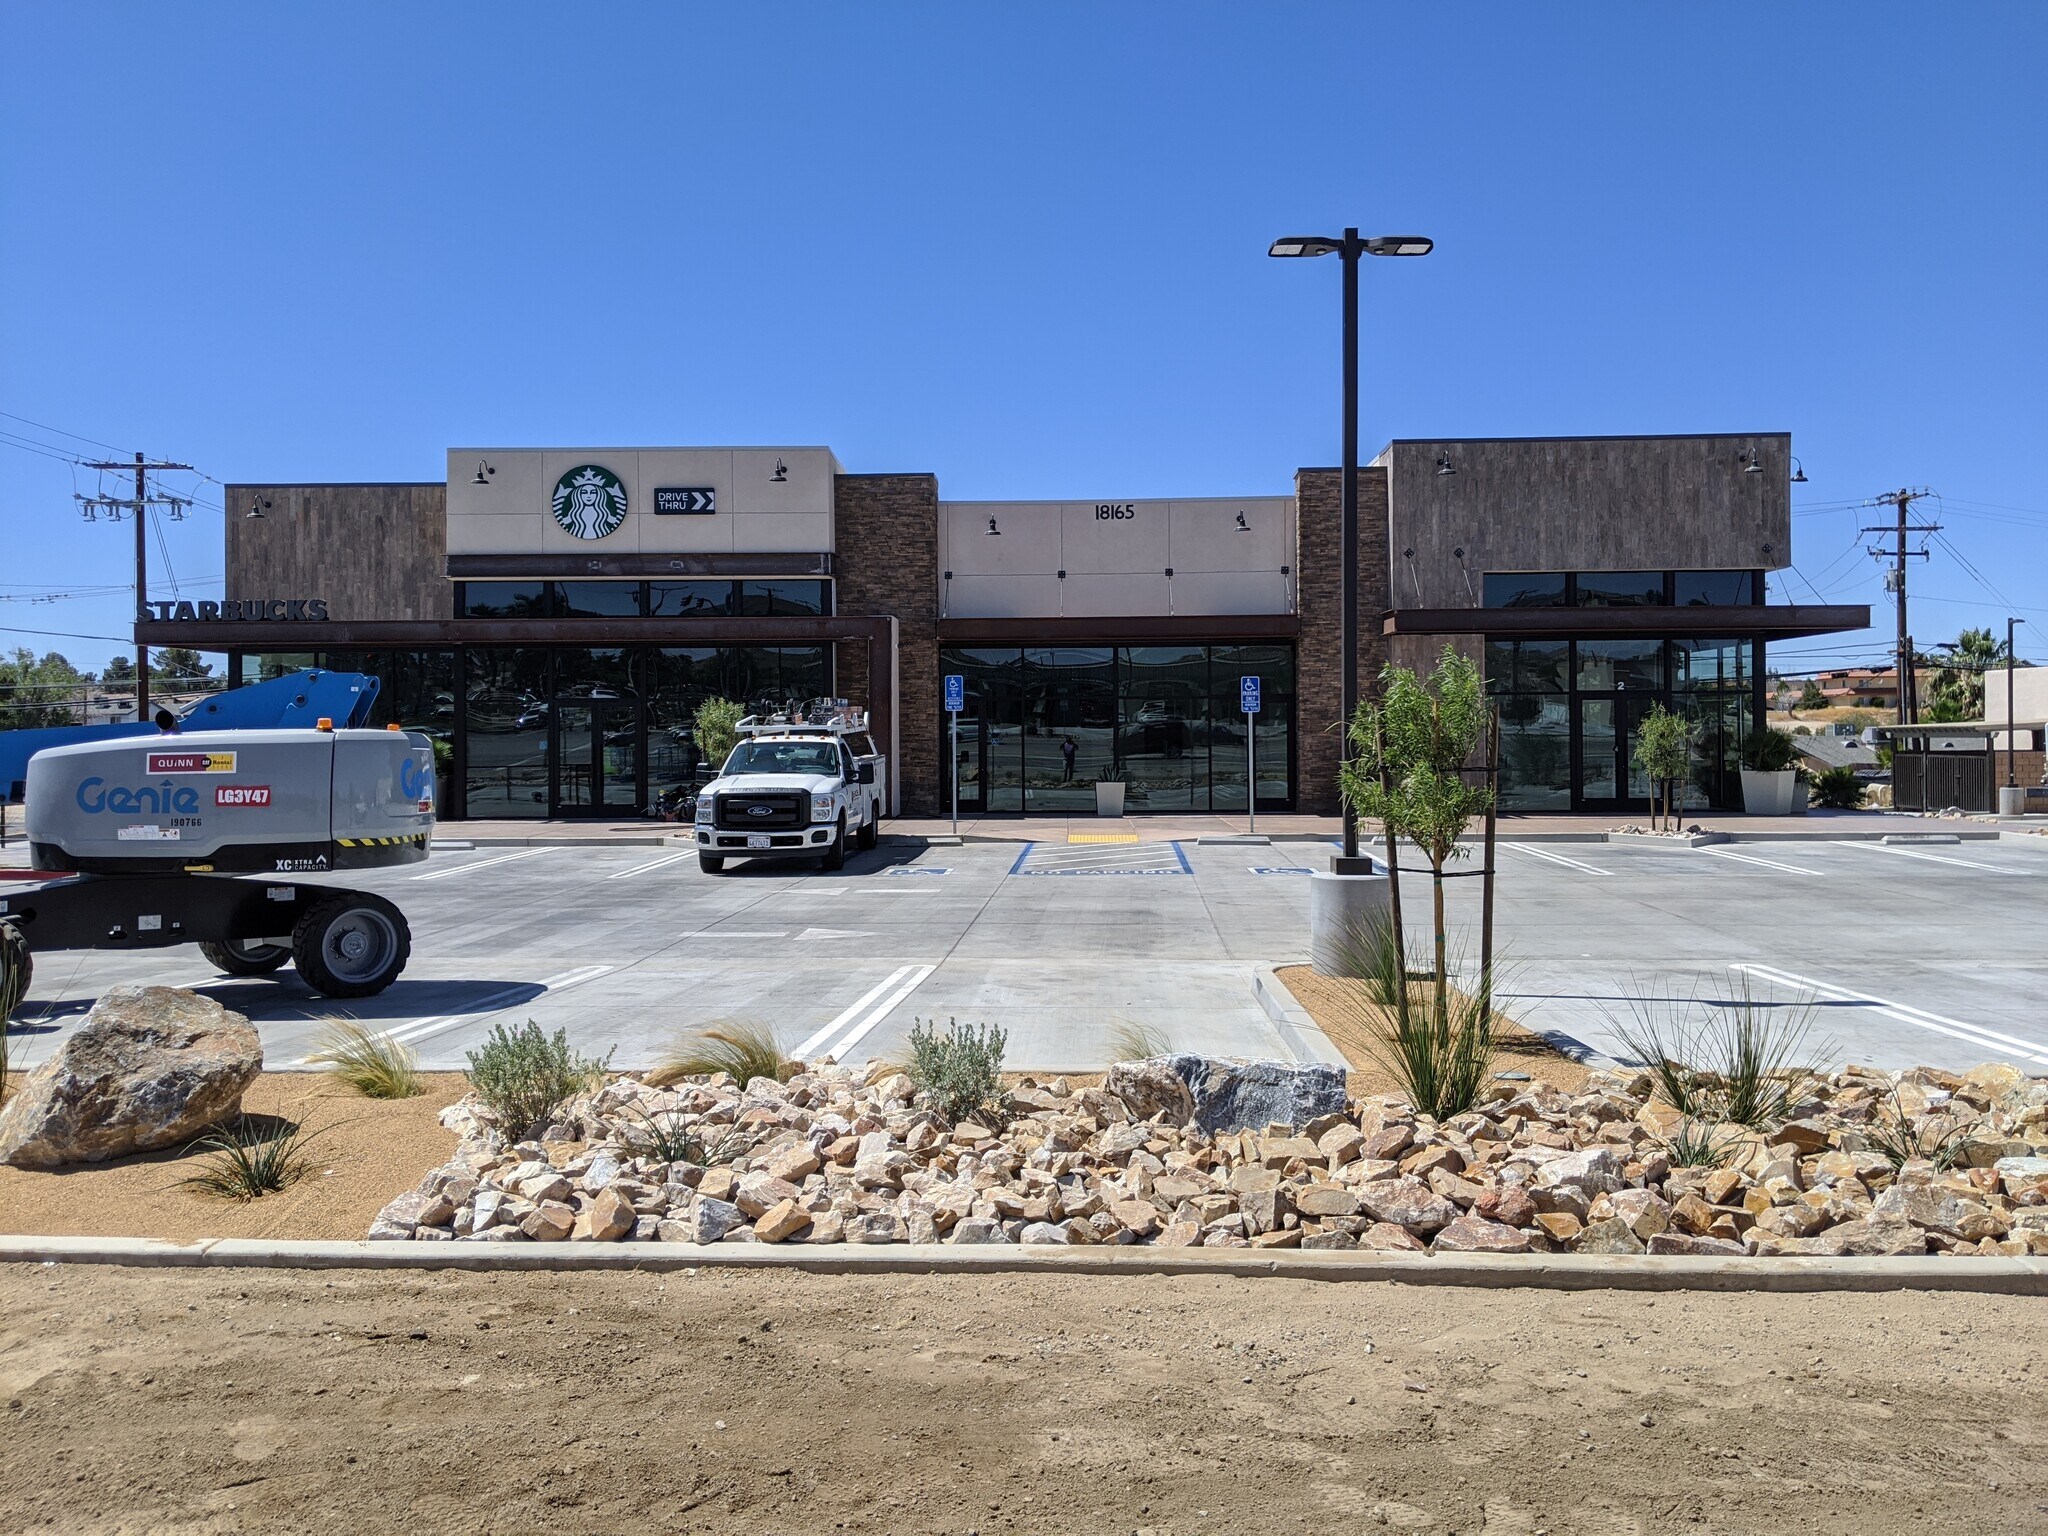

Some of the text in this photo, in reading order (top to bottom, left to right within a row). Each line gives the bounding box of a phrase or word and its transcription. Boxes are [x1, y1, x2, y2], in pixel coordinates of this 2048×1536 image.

[658, 492, 689, 501] DRIVE
[658, 501, 687, 510] THRU
[1095, 504, 1135, 520] 18165
[137, 599, 330, 622] STARBUCKS
[1617, 681, 1625, 690] 2
[77, 777, 199, 814] Genie
[217, 789, 269, 803] LG3Y47
[171, 818, 202, 827] 190766
[276, 859, 292, 870] XC
